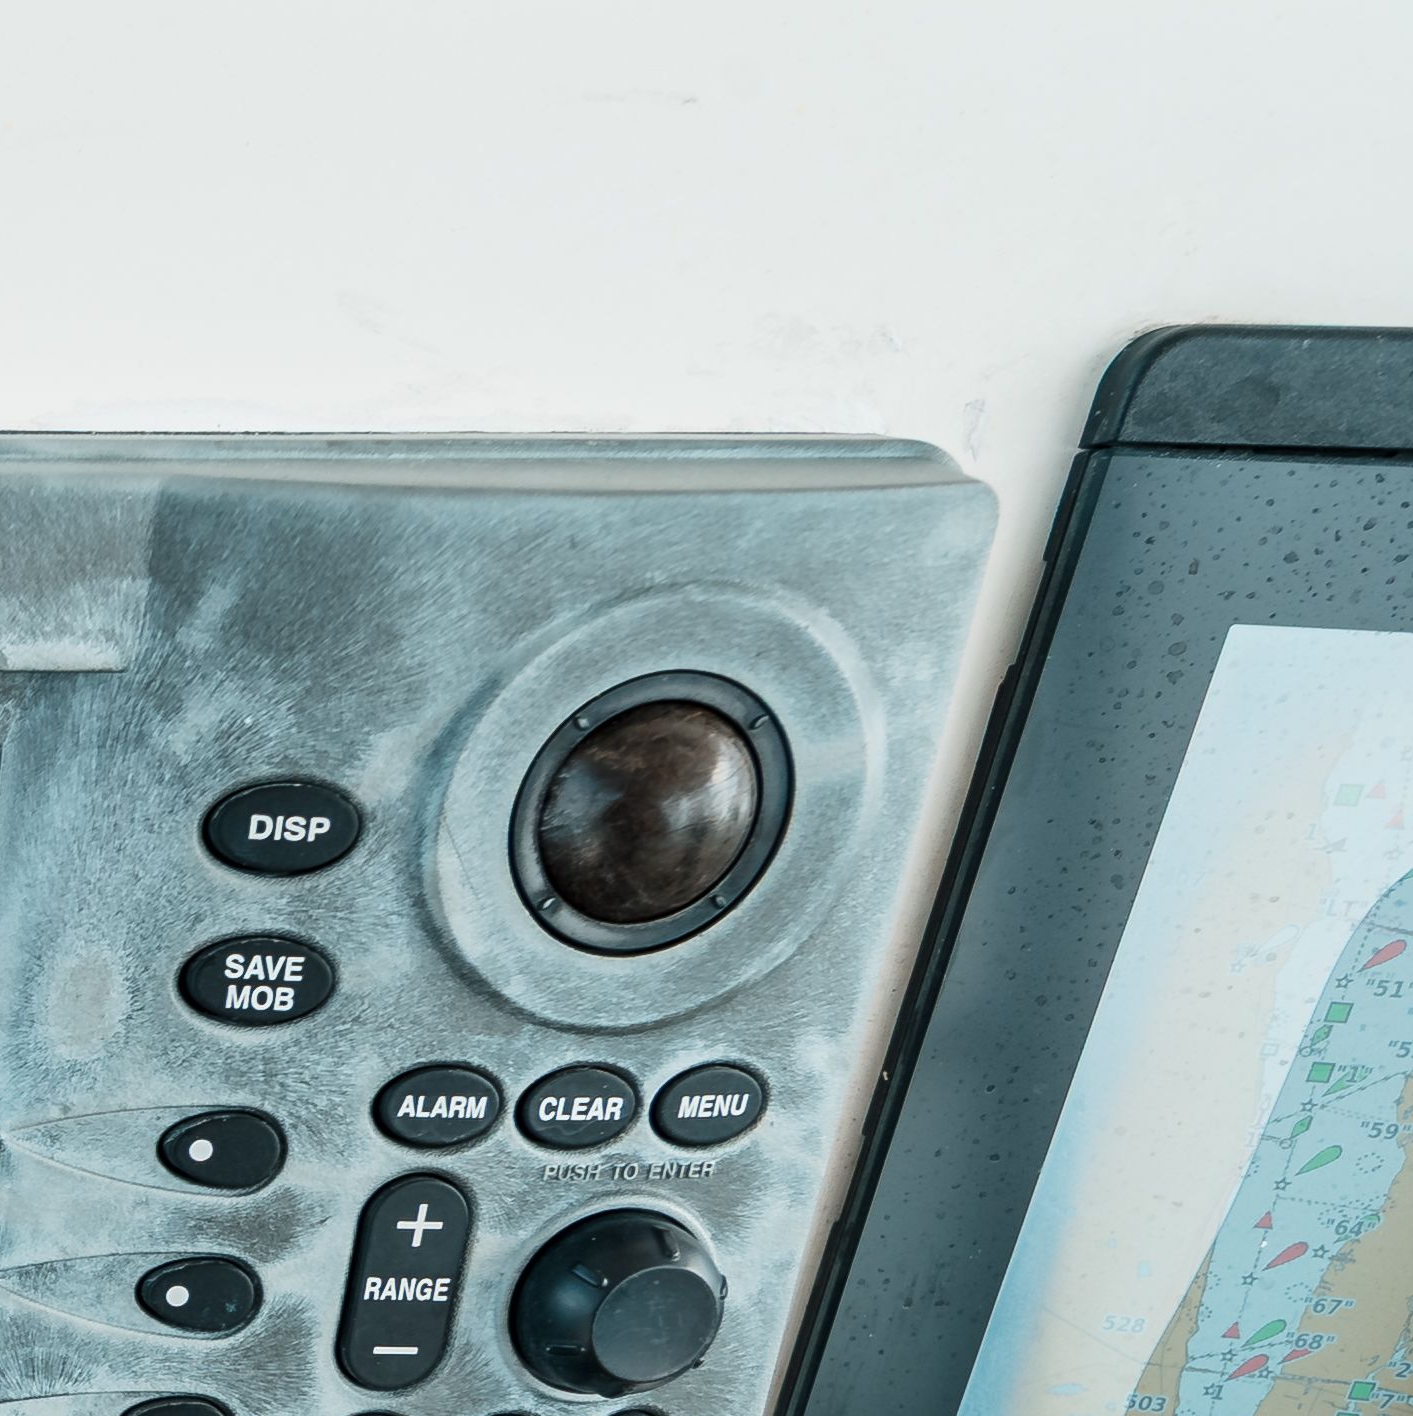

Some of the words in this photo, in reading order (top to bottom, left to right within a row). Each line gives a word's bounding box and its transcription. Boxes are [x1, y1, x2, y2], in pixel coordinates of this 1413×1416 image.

[248, 813, 331, 843] DISP
[224, 953, 305, 982] SAVE
[225, 984, 296, 1012] MOB
[397, 1094, 488, 1120] ALARM
[538, 1097, 624, 1121] CLEAR
[676, 1094, 749, 1119] MENU
[543, 1164, 601, 1182] PUSH
[612, 1163, 641, 1181] TO
[648, 1160, 717, 1180] ENTER
[363, 1276, 451, 1302] RANGE
[1101, 1314, 1146, 1334] 528
[1127, 1394, 1167, 1413] 503
